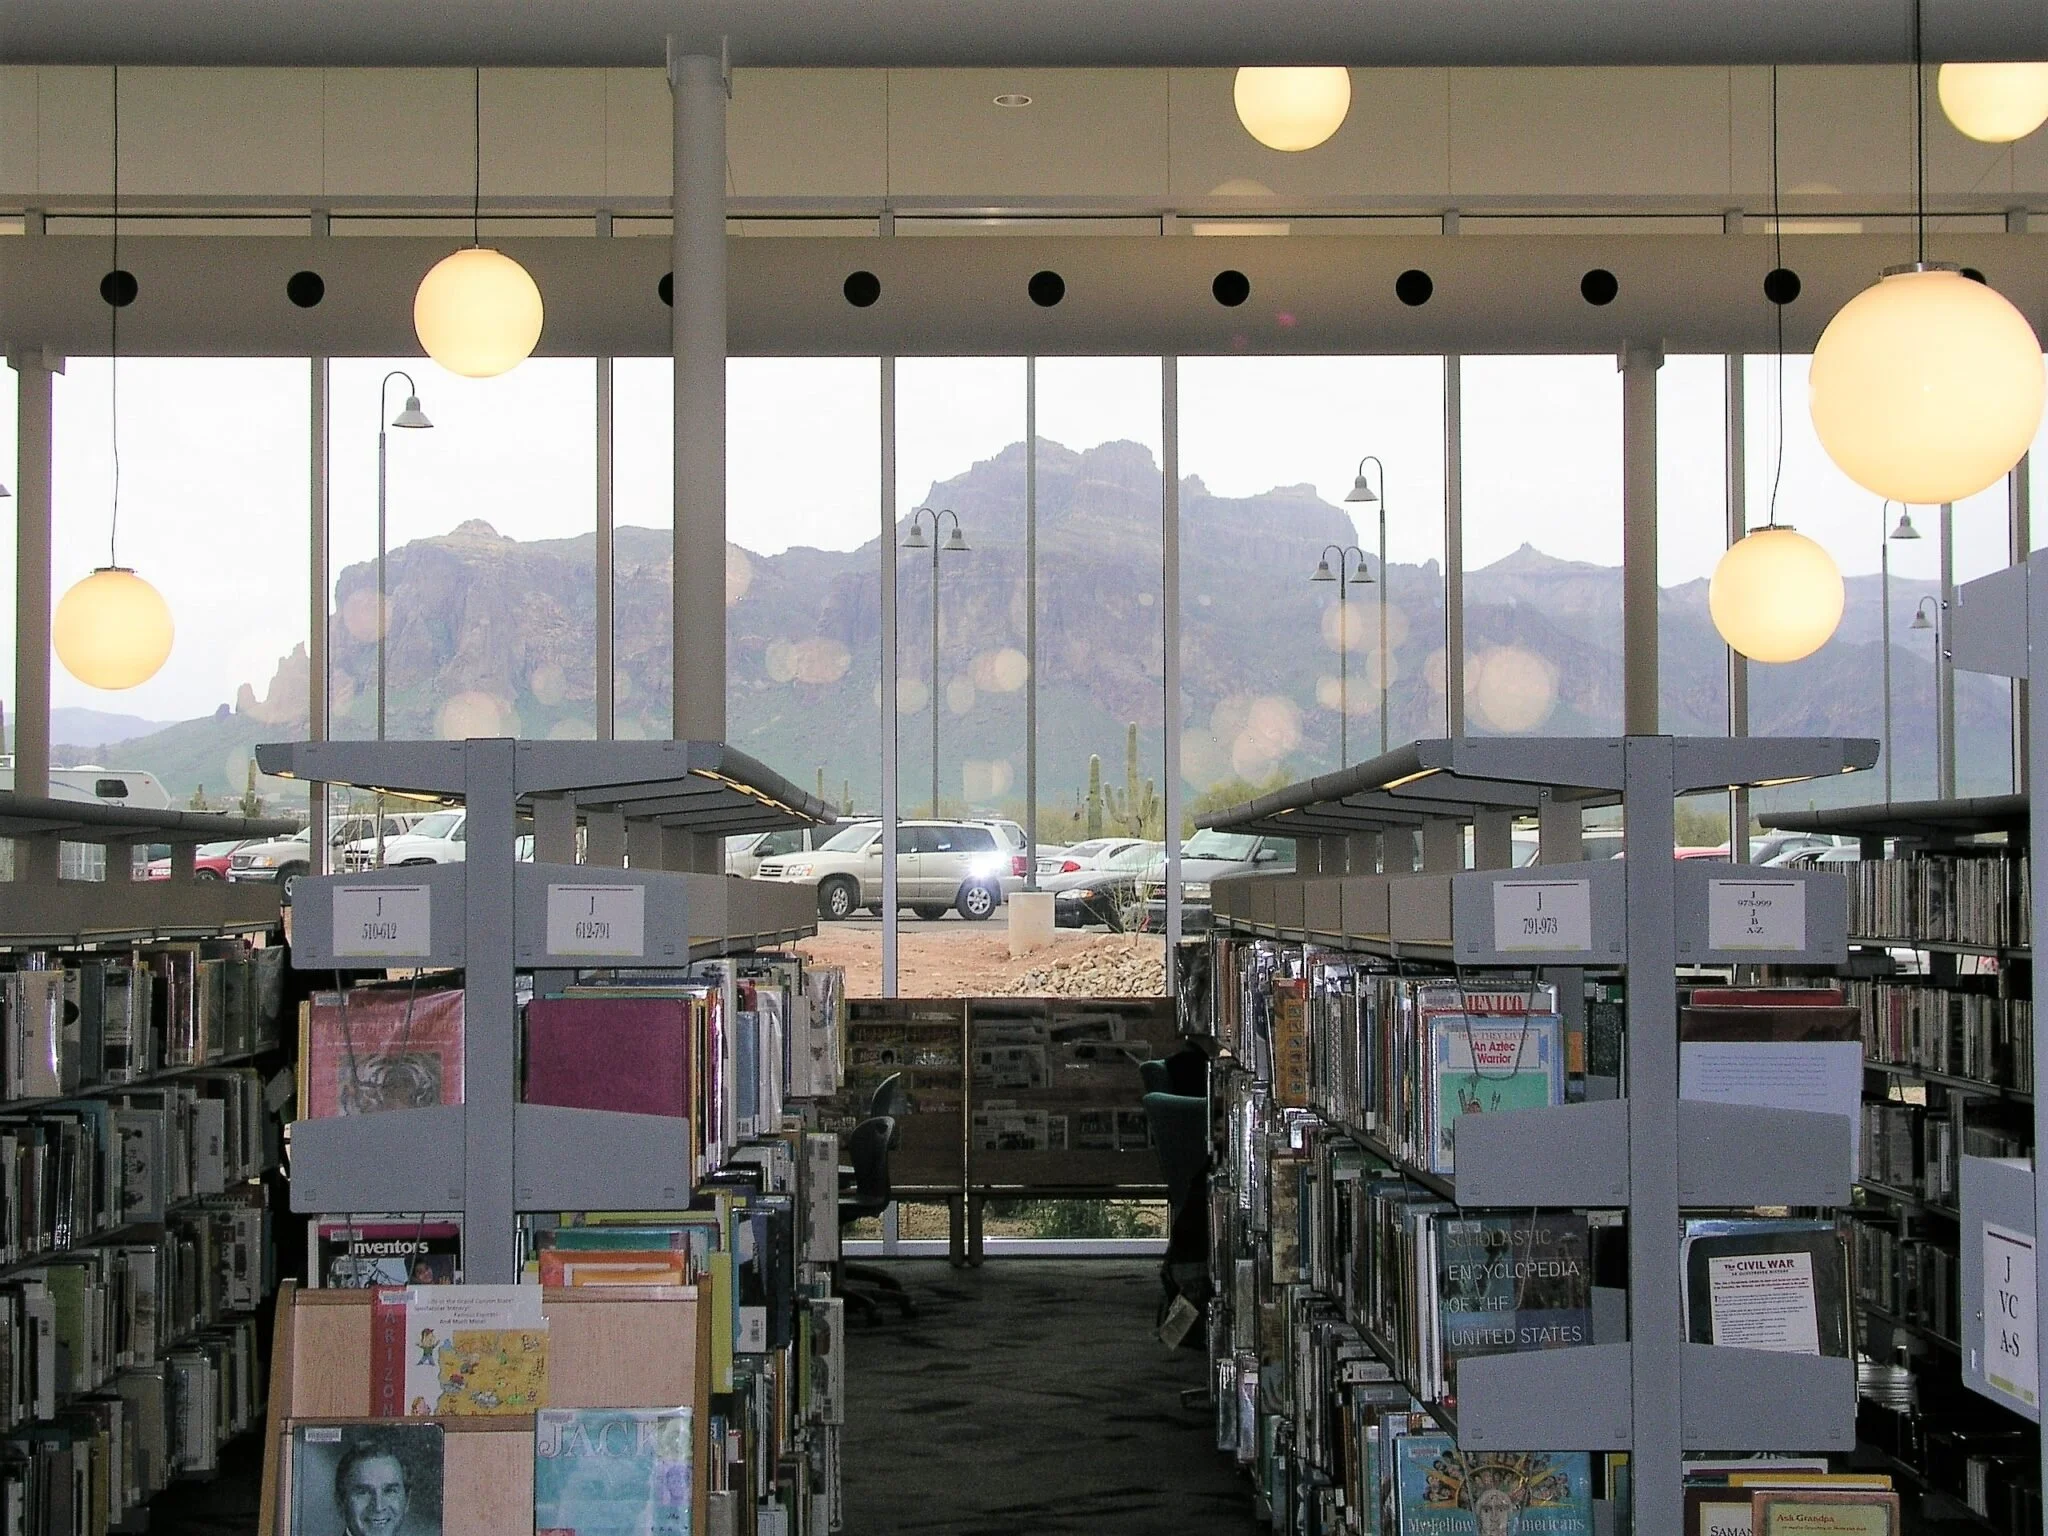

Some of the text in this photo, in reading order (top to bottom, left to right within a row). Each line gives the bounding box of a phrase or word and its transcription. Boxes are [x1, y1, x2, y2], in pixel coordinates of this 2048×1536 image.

[1537, 891, 1542, 911] J
[1750, 890, 1756, 899] J
[376, 896, 382, 917] J
[588, 896, 595, 916] J
[1750, 908, 1756, 917] J
[361, 922, 397, 940] 510-612
[575, 921, 610, 940] 612-791
[1523, 917, 1558, 935] 791-973
[1474, 1040, 1516, 1052] An Aztec
[1477, 1053, 1512, 1064] Warrior
[348, 1240, 429, 1255] nventors
[1448, 1261, 1580, 1281] ENCYCLOPEDIA
[1736, 1261, 1766, 1271] CIVIL
[1767, 1259, 1795, 1269] WAR
[2004, 1256, 2010, 1283] J
[1999, 1290, 2019, 1319] VC
[1451, 1325, 1583, 1346] UNITED STATES
[2000, 1328, 2020, 1358] A-S
[1429, 1516, 1474, 1533] Fellow
[1776, 1514, 1835, 1524] Ask Grandpa
